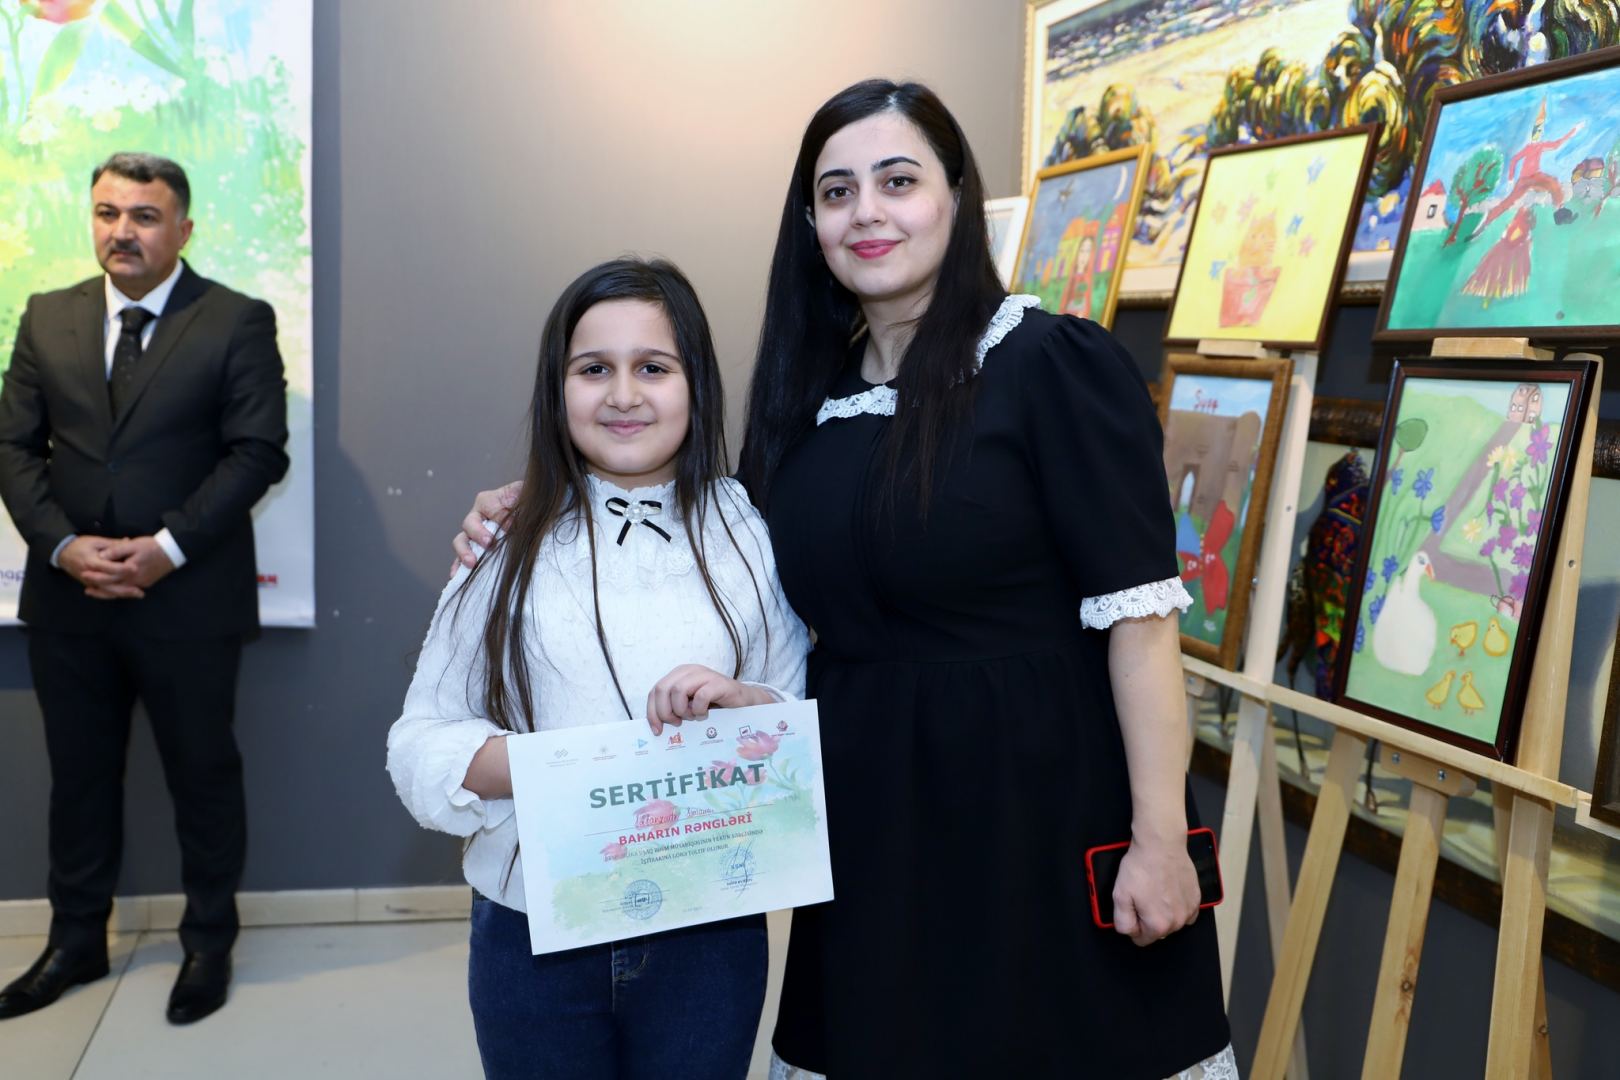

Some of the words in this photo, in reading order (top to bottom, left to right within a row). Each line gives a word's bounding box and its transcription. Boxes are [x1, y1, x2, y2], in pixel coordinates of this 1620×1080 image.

[589, 763, 765, 809] SERTİFİKAT
[619, 826, 680, 846] BAHARIN
[684, 811, 753, 834] RƏNGLƏRİ
